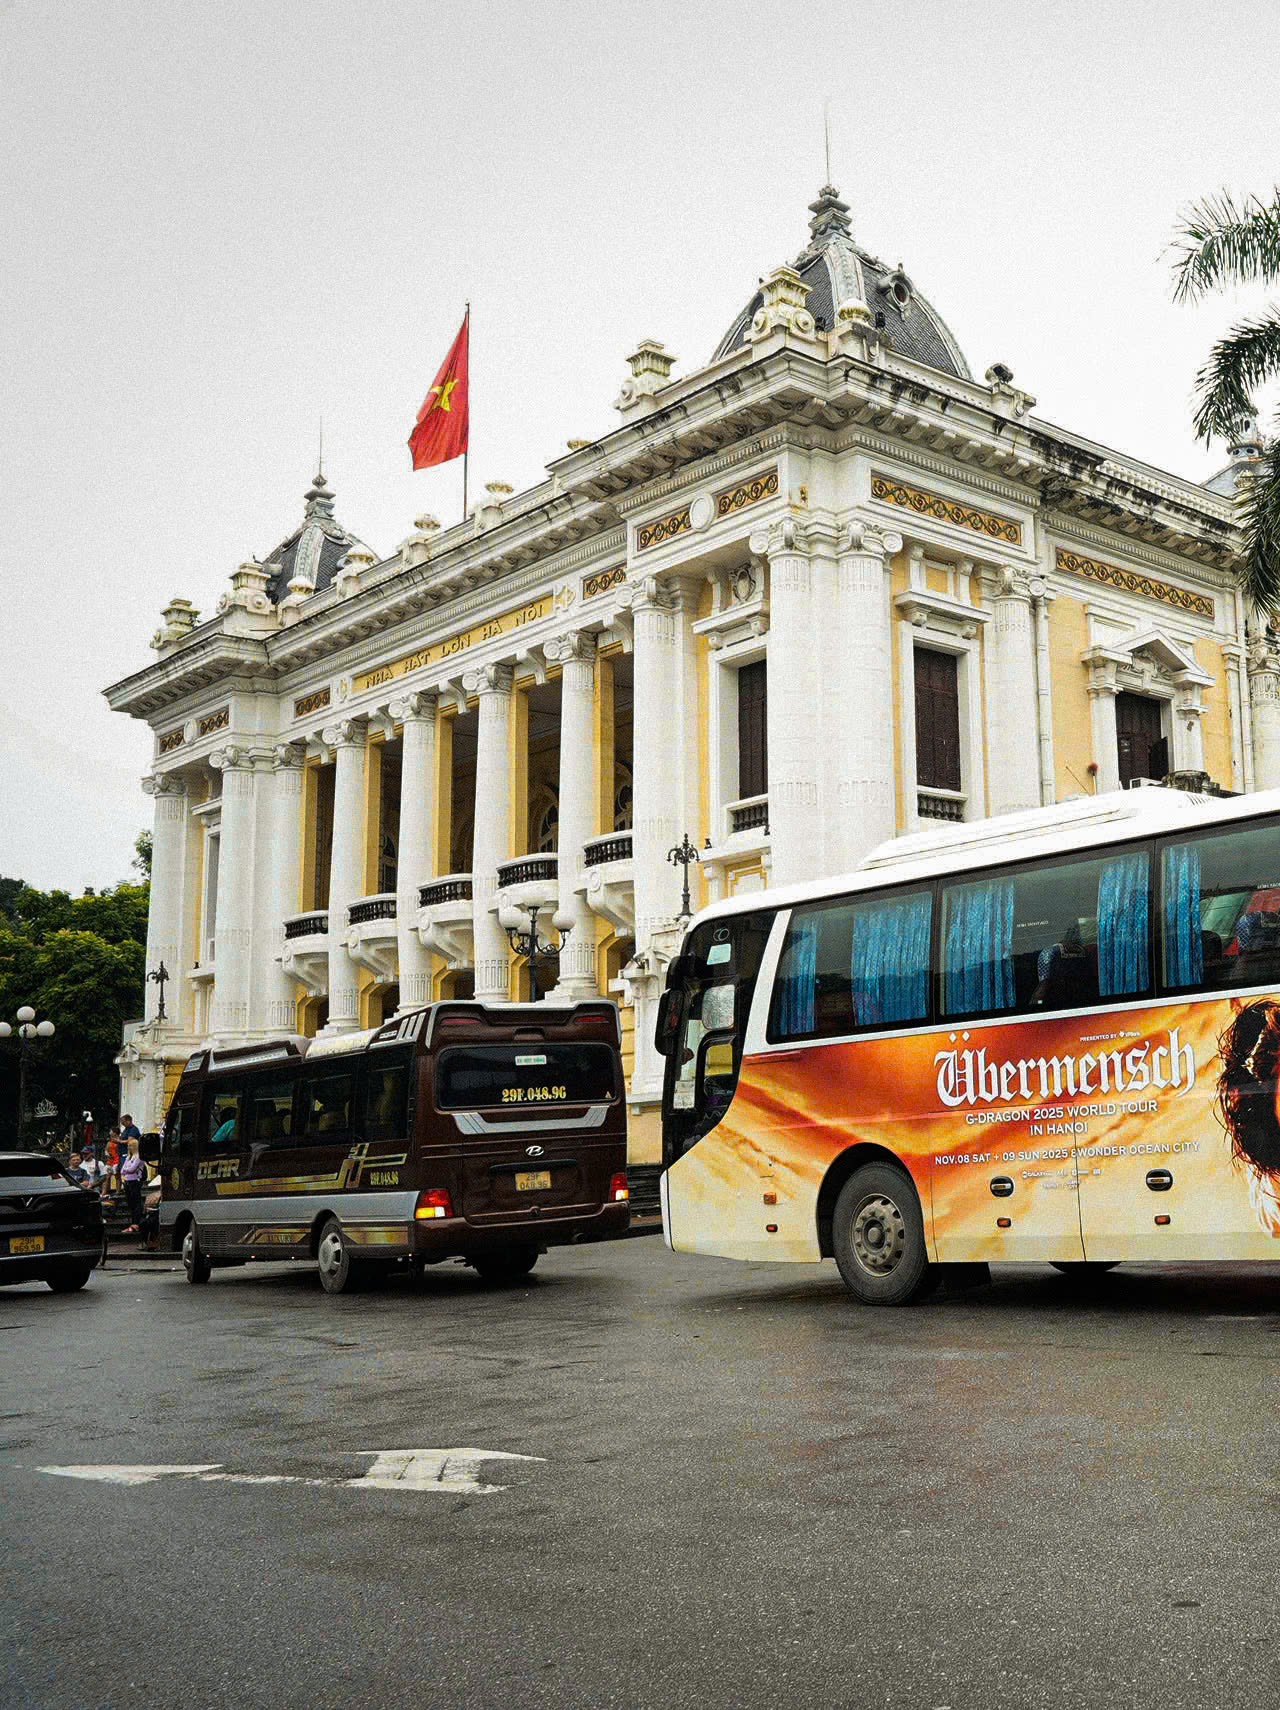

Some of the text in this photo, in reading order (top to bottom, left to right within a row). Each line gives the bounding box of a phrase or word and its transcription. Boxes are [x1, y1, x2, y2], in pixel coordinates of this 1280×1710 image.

[934, 1026, 1196, 1107] Übermensch
[966, 1100, 1158, 1124] G-DRAGON 2025 WORLD TOUR
[1030, 1122, 1088, 1136] IN HANOI
[935, 1154, 969, 1165] NOV.08
[972, 1153, 991, 1162] SAT
[1002, 1152, 1015, 1161] 09
[1018, 1151, 1039, 1160] SUN
[1042, 1149, 1068, 1159] 2025
[1129, 1143, 1170, 1154] OCEAN
[1173, 1142, 1200, 1152] CITY
